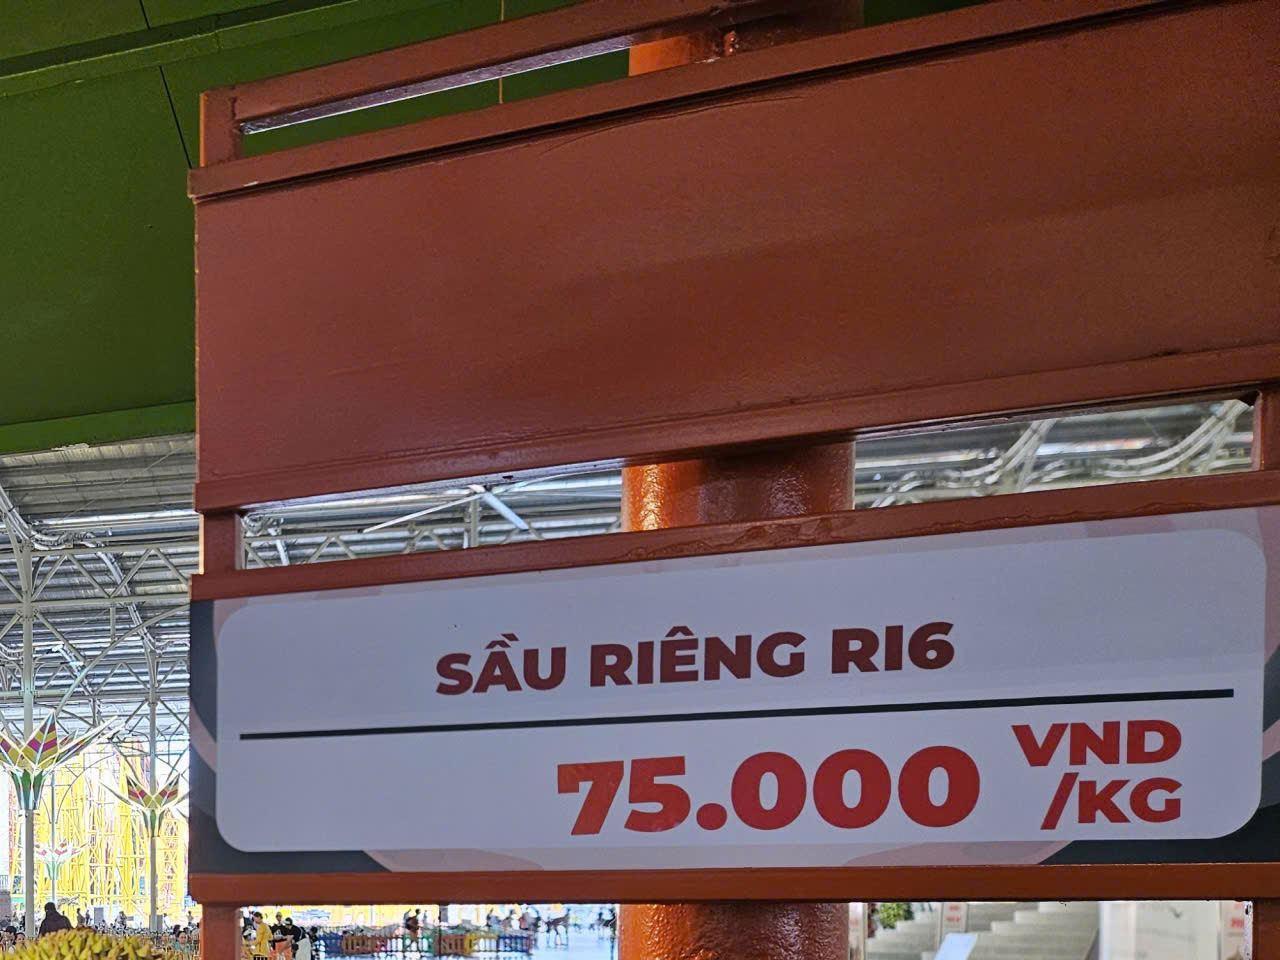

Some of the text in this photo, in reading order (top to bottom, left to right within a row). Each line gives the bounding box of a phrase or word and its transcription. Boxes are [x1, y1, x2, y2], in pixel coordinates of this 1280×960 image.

[435, 621, 955, 696] SẦU RIÊNG RI6
[1011, 718, 1183, 768] VND
[556, 744, 981, 836] 75.000
[1039, 771, 1183, 831] /KG
